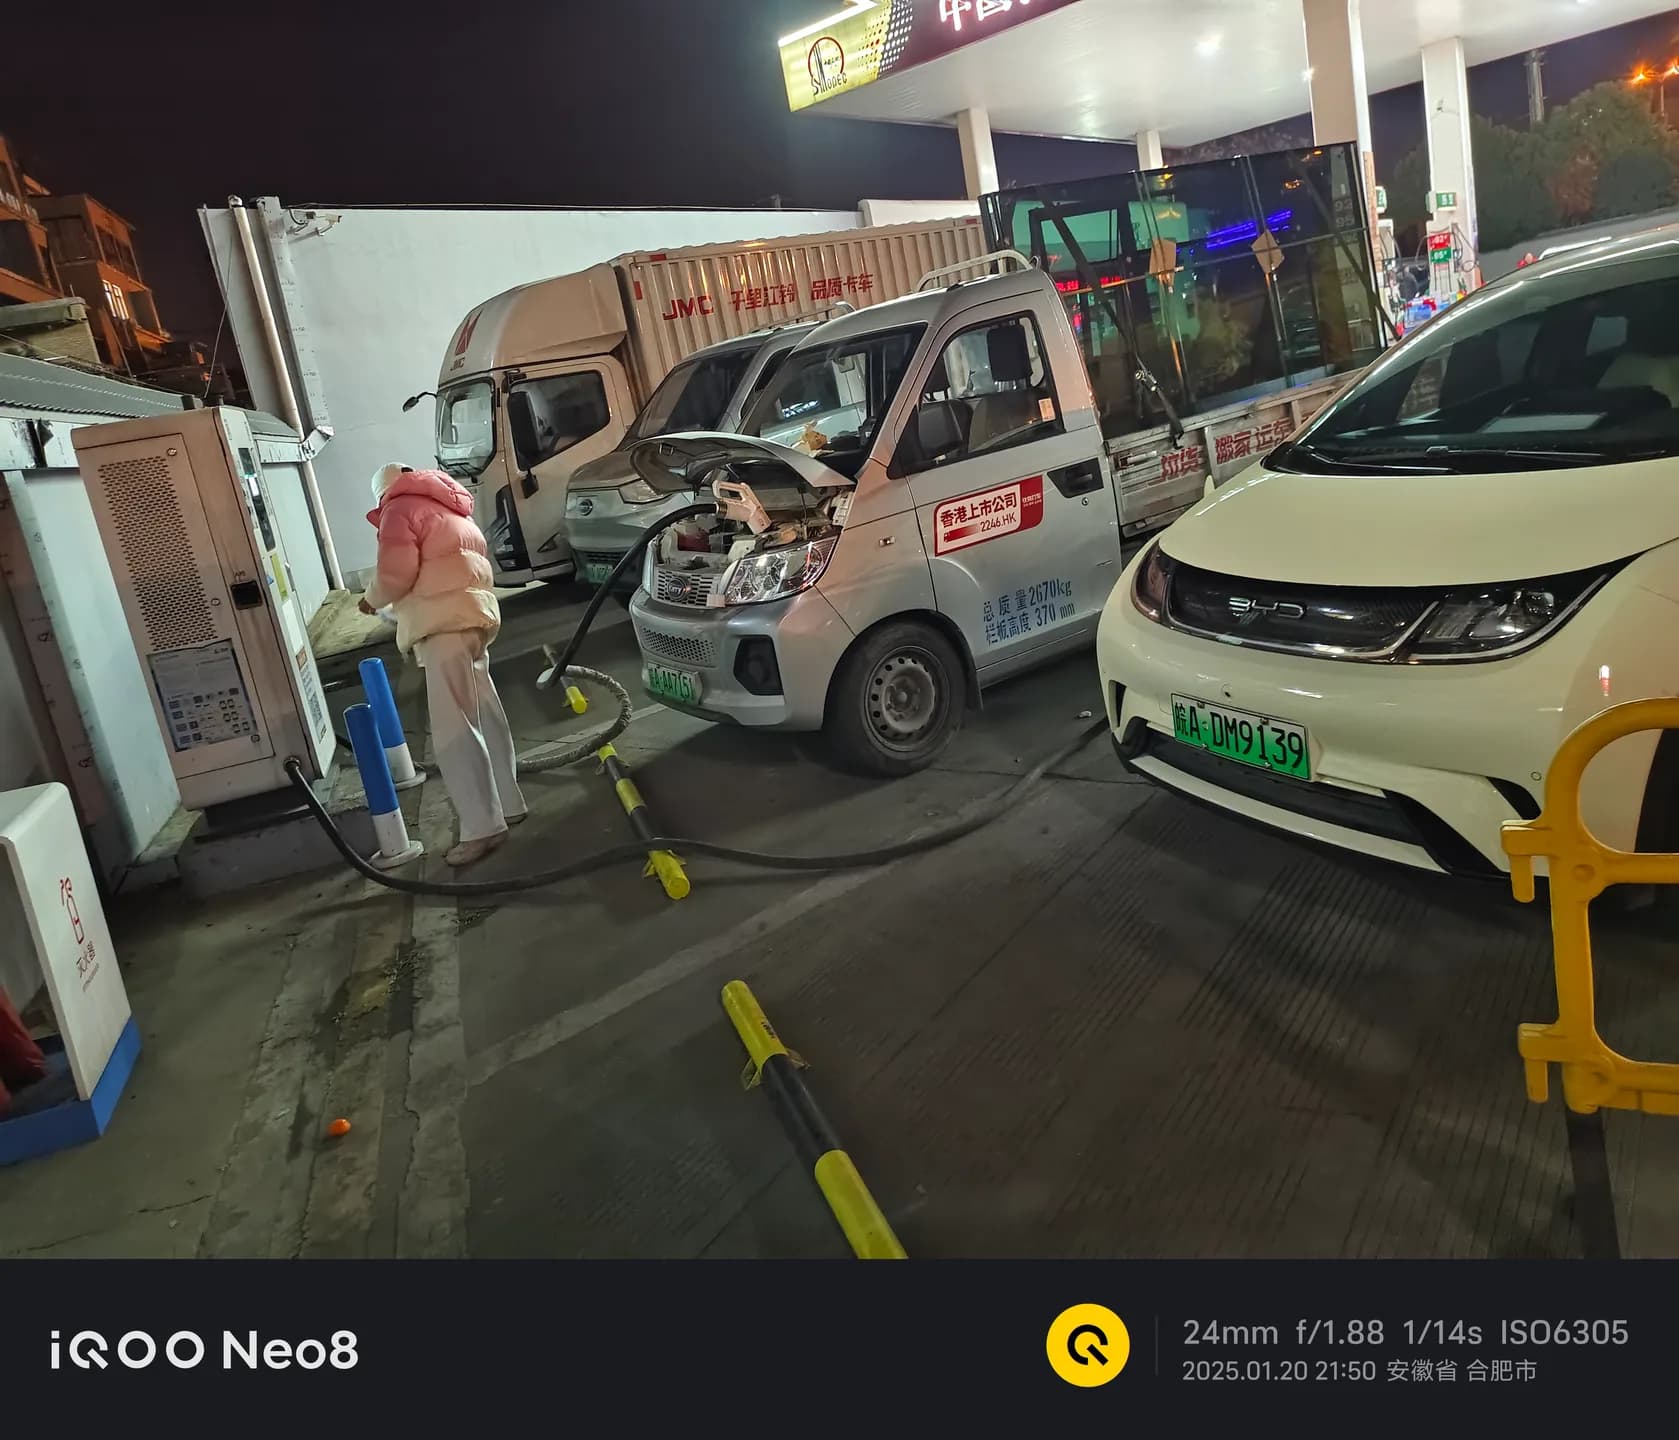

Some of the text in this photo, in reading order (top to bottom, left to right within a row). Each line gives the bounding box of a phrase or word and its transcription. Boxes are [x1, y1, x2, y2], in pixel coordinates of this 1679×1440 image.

[662, 295, 714, 320] JMC
[811, 273, 873, 300] 品质卡车
[941, 492, 1018, 528] 香港上市公司
[980, 512, 1017, 532] 2246.HK
[985, 614, 1032, 646] 栏板高度
[1035, 604, 1057, 627] 370
[1229, 597, 1305, 620] BYD
